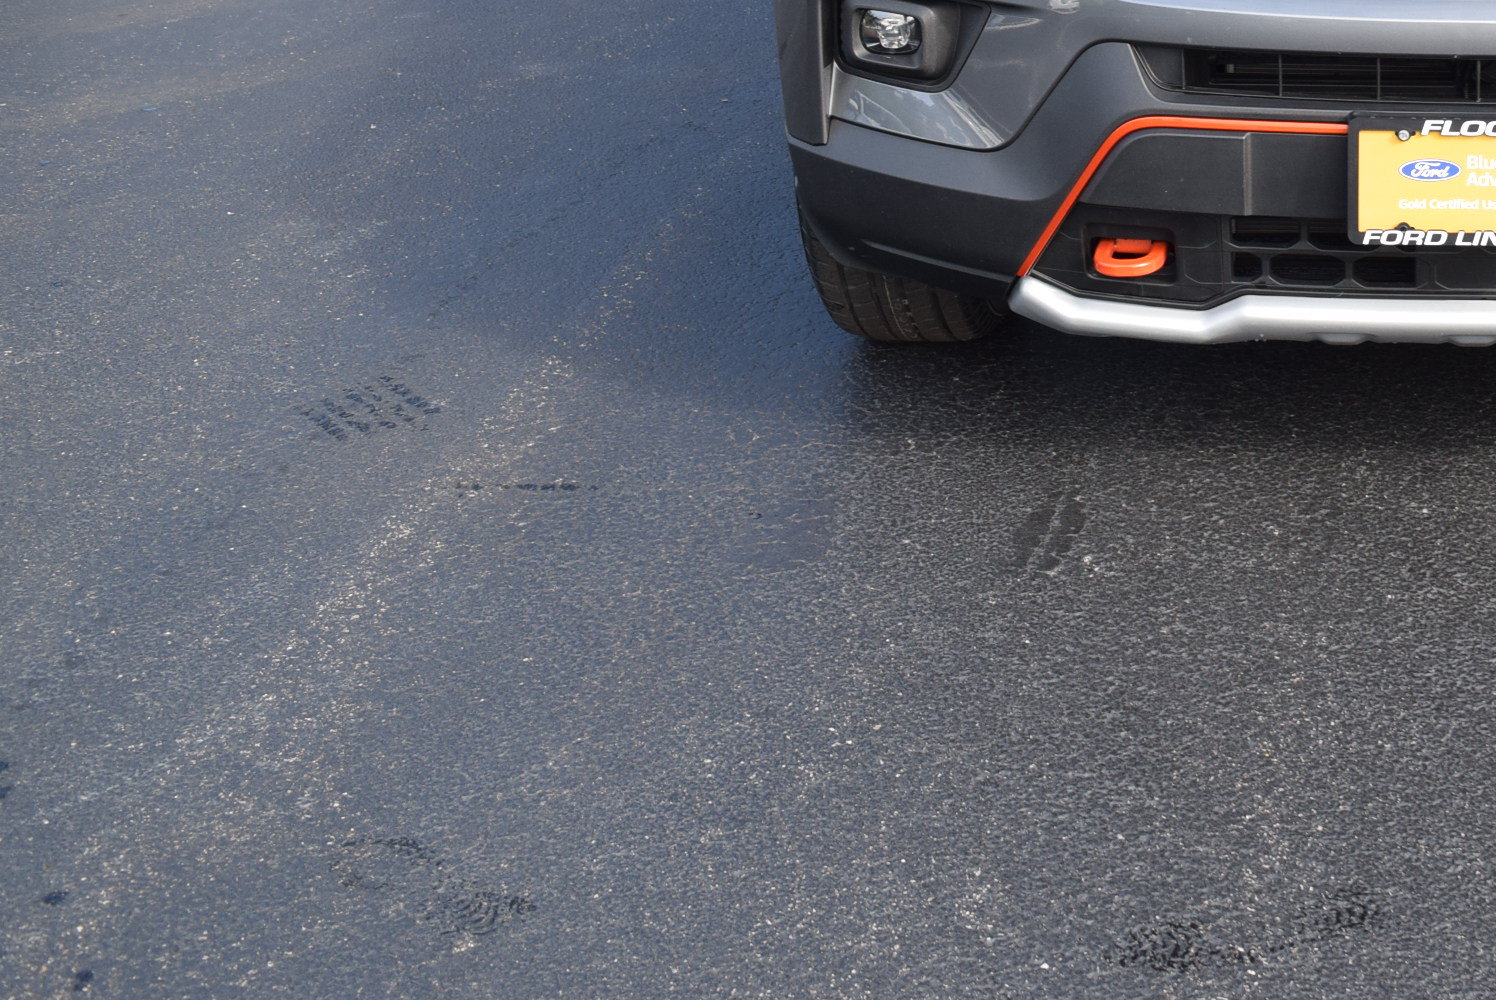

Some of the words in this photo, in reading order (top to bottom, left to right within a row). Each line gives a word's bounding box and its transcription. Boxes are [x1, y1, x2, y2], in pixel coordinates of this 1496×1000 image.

[1410, 161, 1451, 178] Ford
[1398, 199, 1427, 210] Gold
[1429, 199, 1480, 211] Certified
[1362, 230, 1448, 246] FORD
